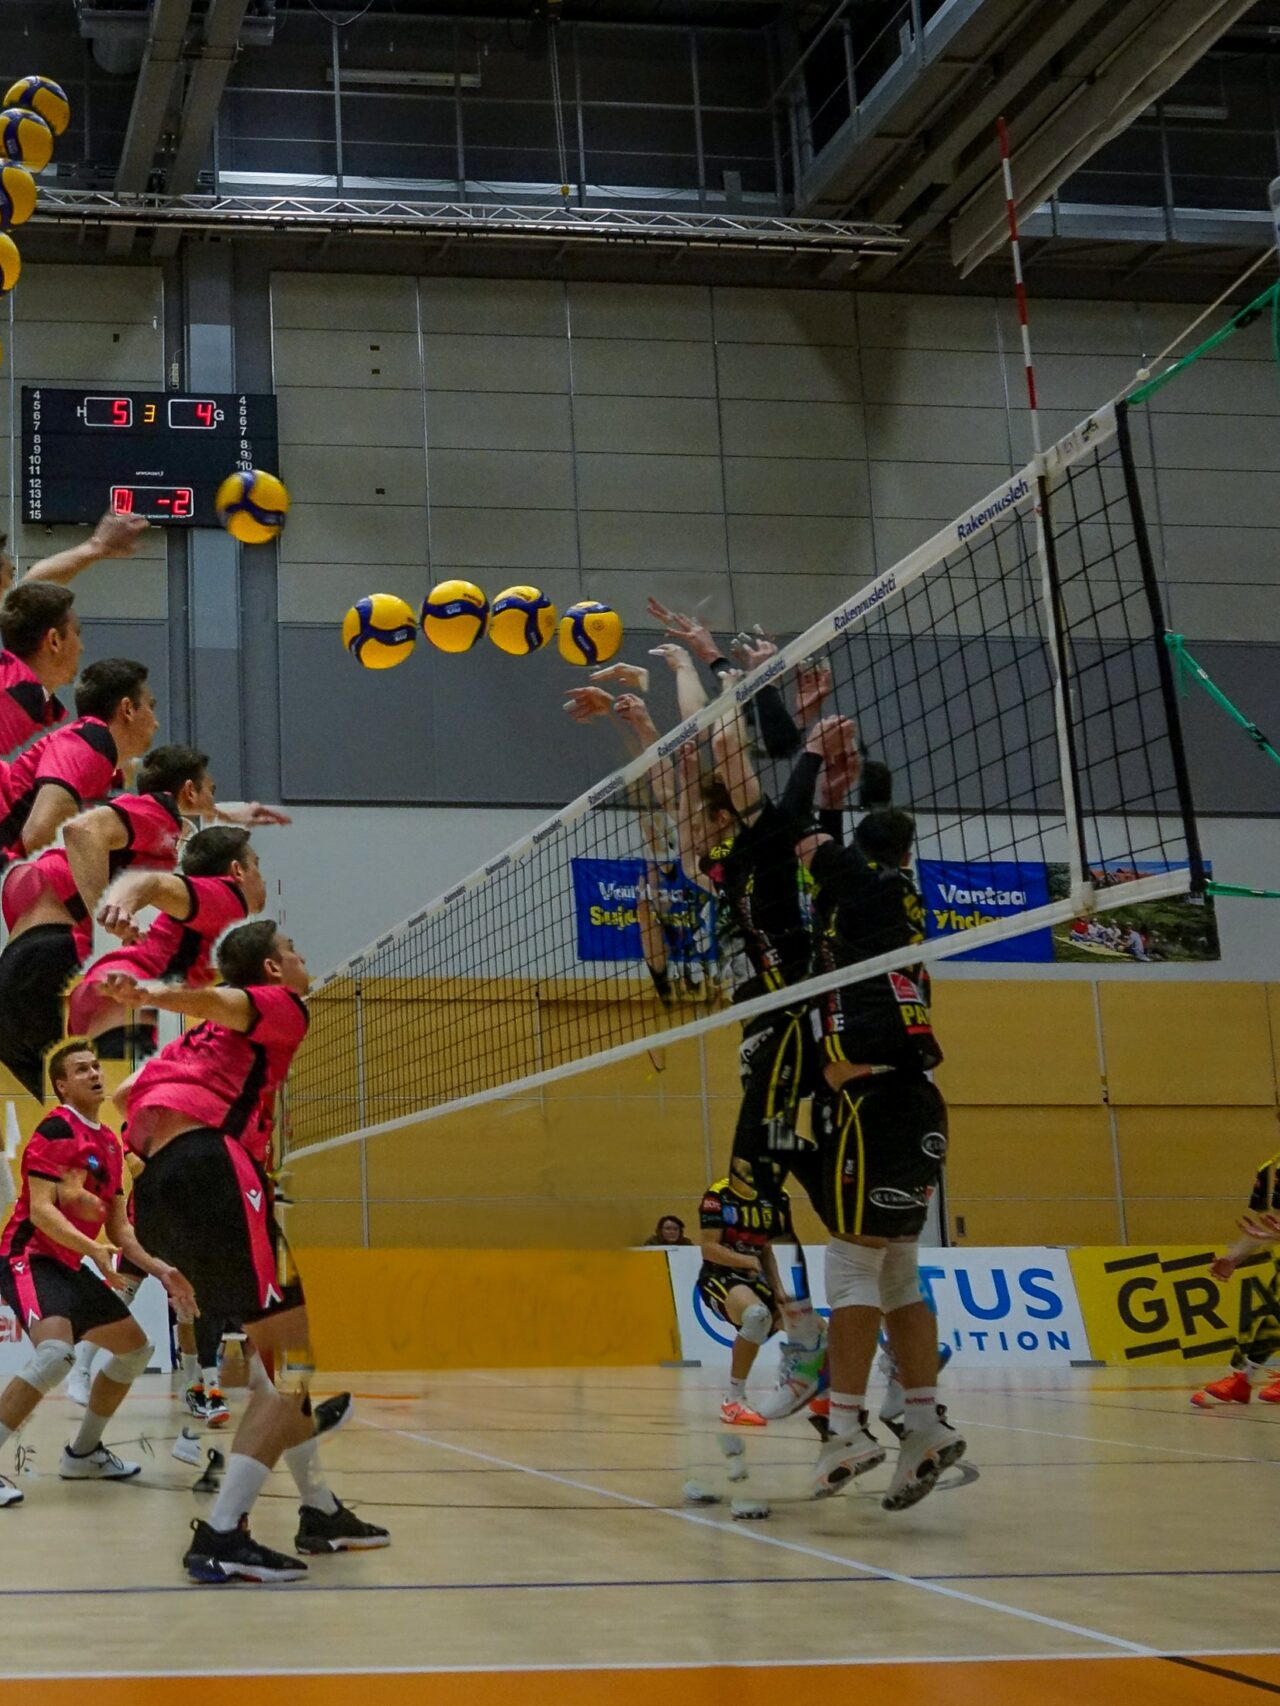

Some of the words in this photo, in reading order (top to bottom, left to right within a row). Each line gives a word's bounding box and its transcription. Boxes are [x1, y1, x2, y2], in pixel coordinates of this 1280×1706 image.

[33, 390, 40, 400] 4
[33, 401, 41, 410] 5
[240, 396, 247, 405] 4
[33, 411, 41, 420] 6
[77, 406, 87, 417] H
[113, 400, 128, 425] 5
[143, 404, 156, 422] 3
[196, 403, 212, 426] 4
[213, 409, 224, 421] G
[240, 406, 247, 415] 5
[33, 421, 40, 431] 7
[240, 416, 247, 426] 6
[240, 426, 247, 436] 7
[33, 434, 41, 444] 8
[33, 445, 41, 454] 9
[240, 440, 248, 449] 8
[28, 455, 41, 465] 10
[28, 466, 41, 475] 11
[29, 479, 41, 488] 12
[29, 489, 41, 499] 13
[29, 499, 41, 509] 14
[29, 510, 41, 519] 15
[833, 573, 897, 632] Rakennuslehti
[937, 883, 1027, 906] Vantaa
[932, 909, 1007, 931] Yhde
[900, 1004, 929, 1025] PA
